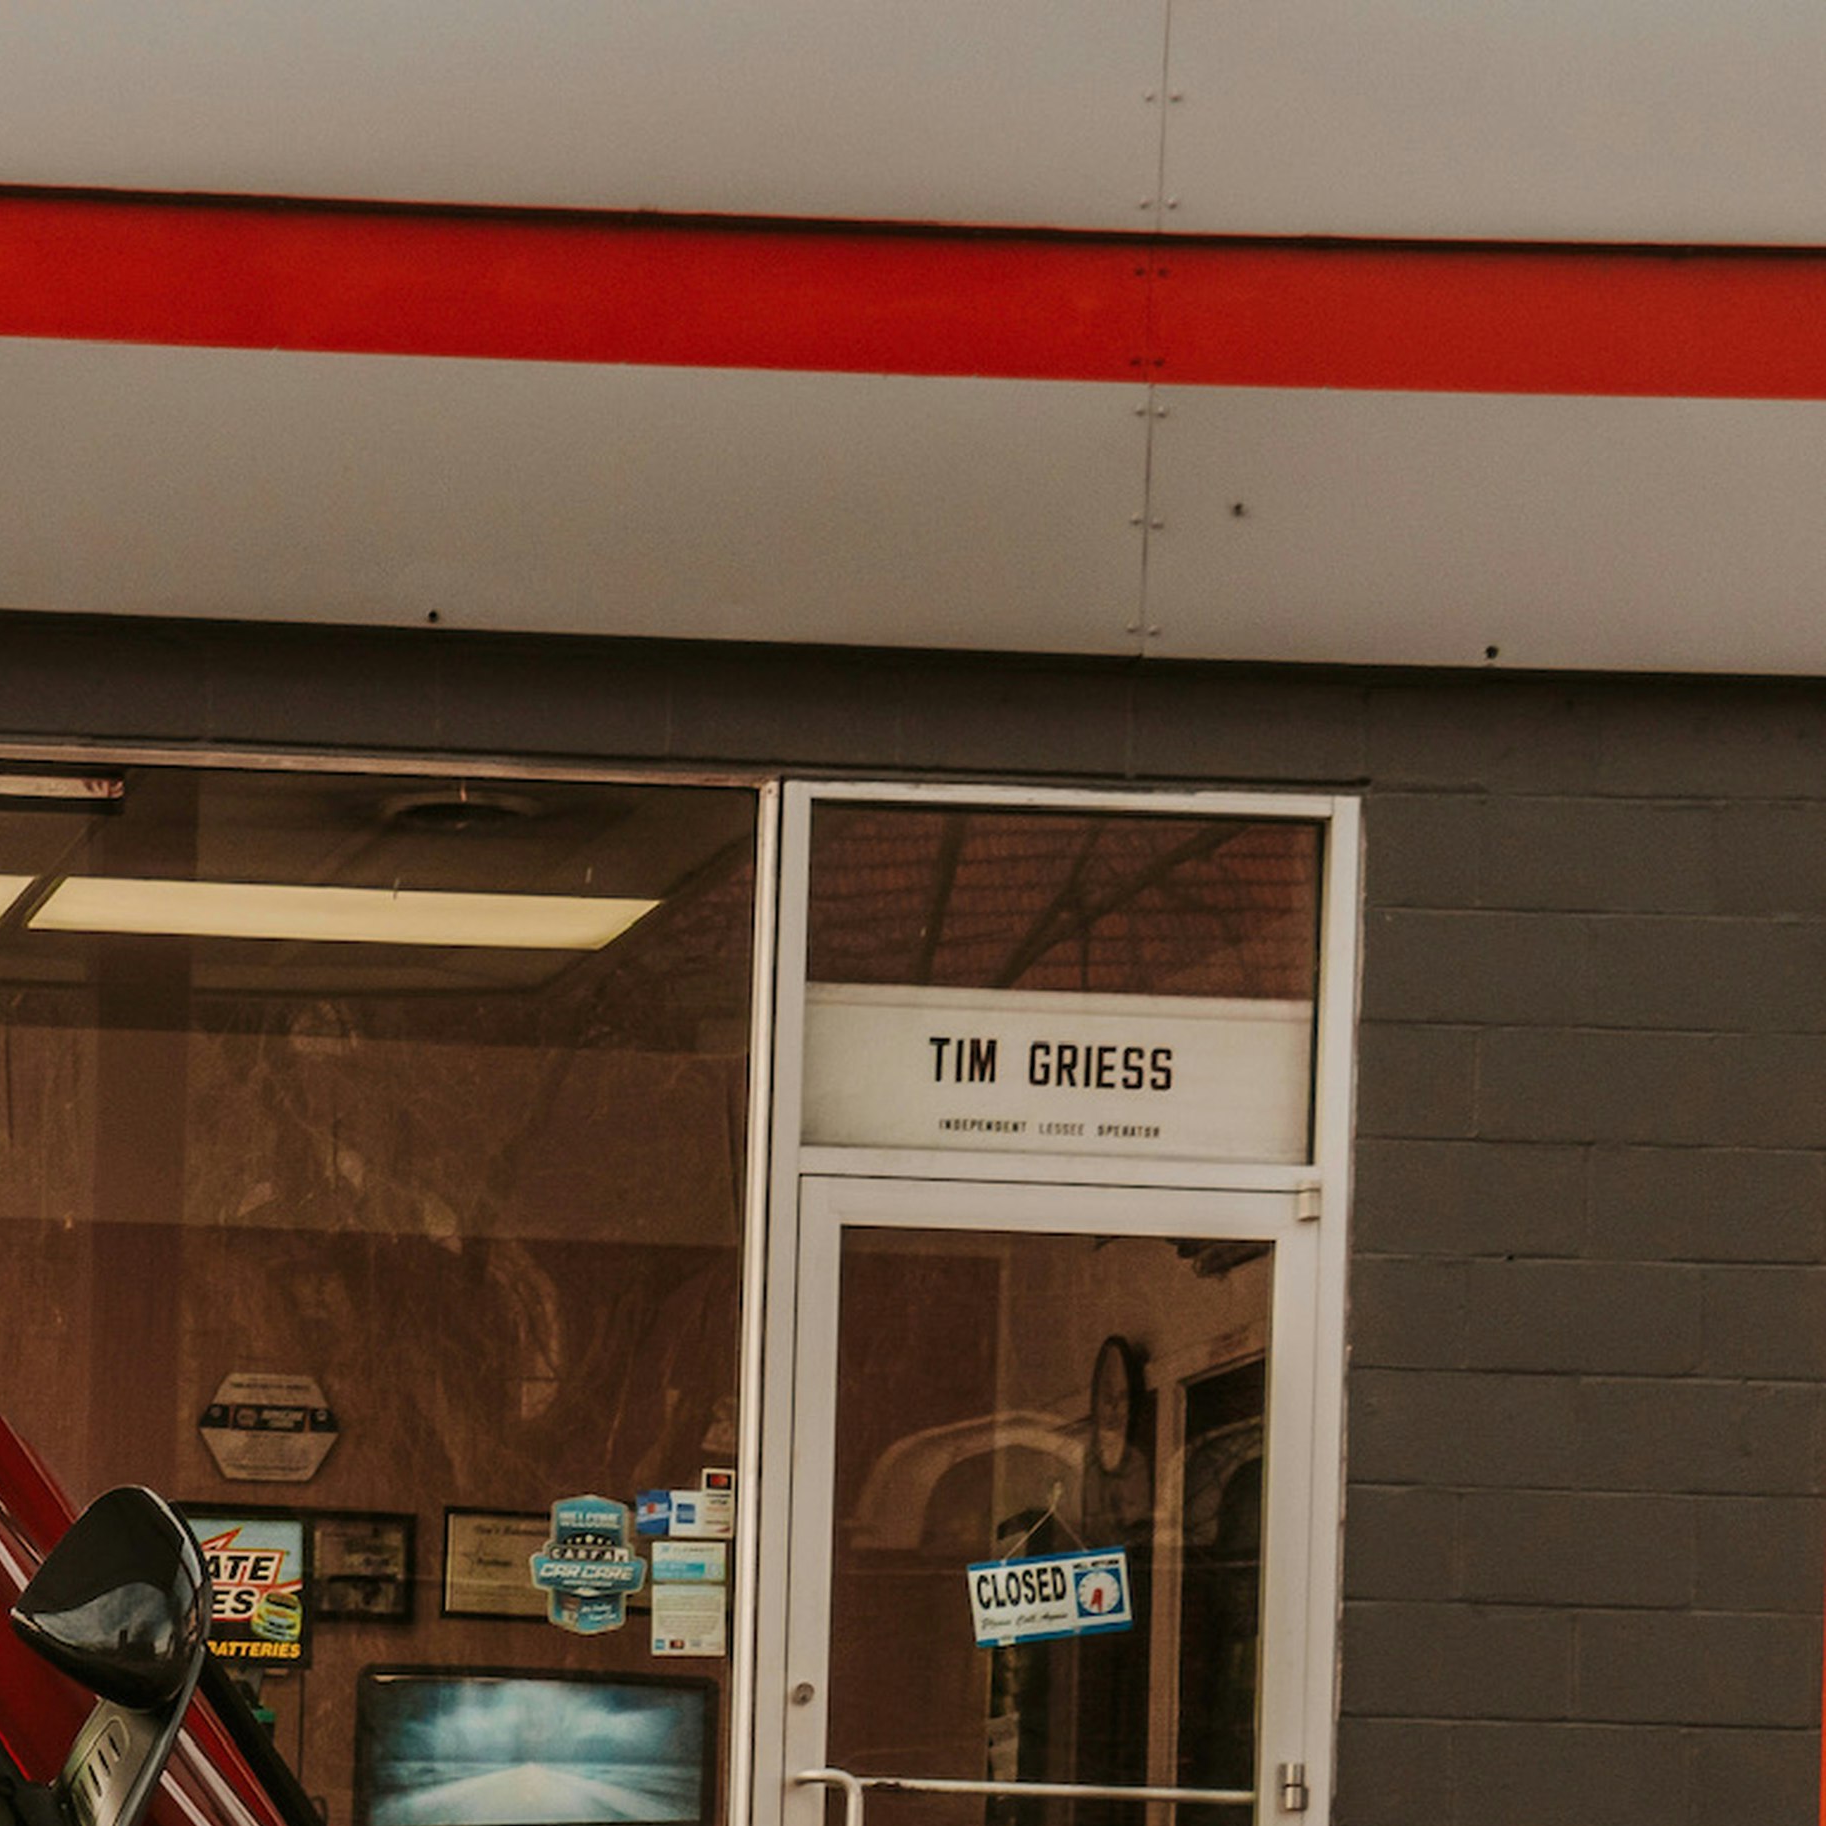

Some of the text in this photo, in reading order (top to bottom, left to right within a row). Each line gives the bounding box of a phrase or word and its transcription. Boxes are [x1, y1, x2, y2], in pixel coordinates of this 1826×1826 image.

[929, 1037, 1173, 1091] TIM GRIESS
[939, 1118, 1161, 1138] INDEPENDENT LESSEE OPERATOR
[976, 1566, 1067, 1610] CLOSED
